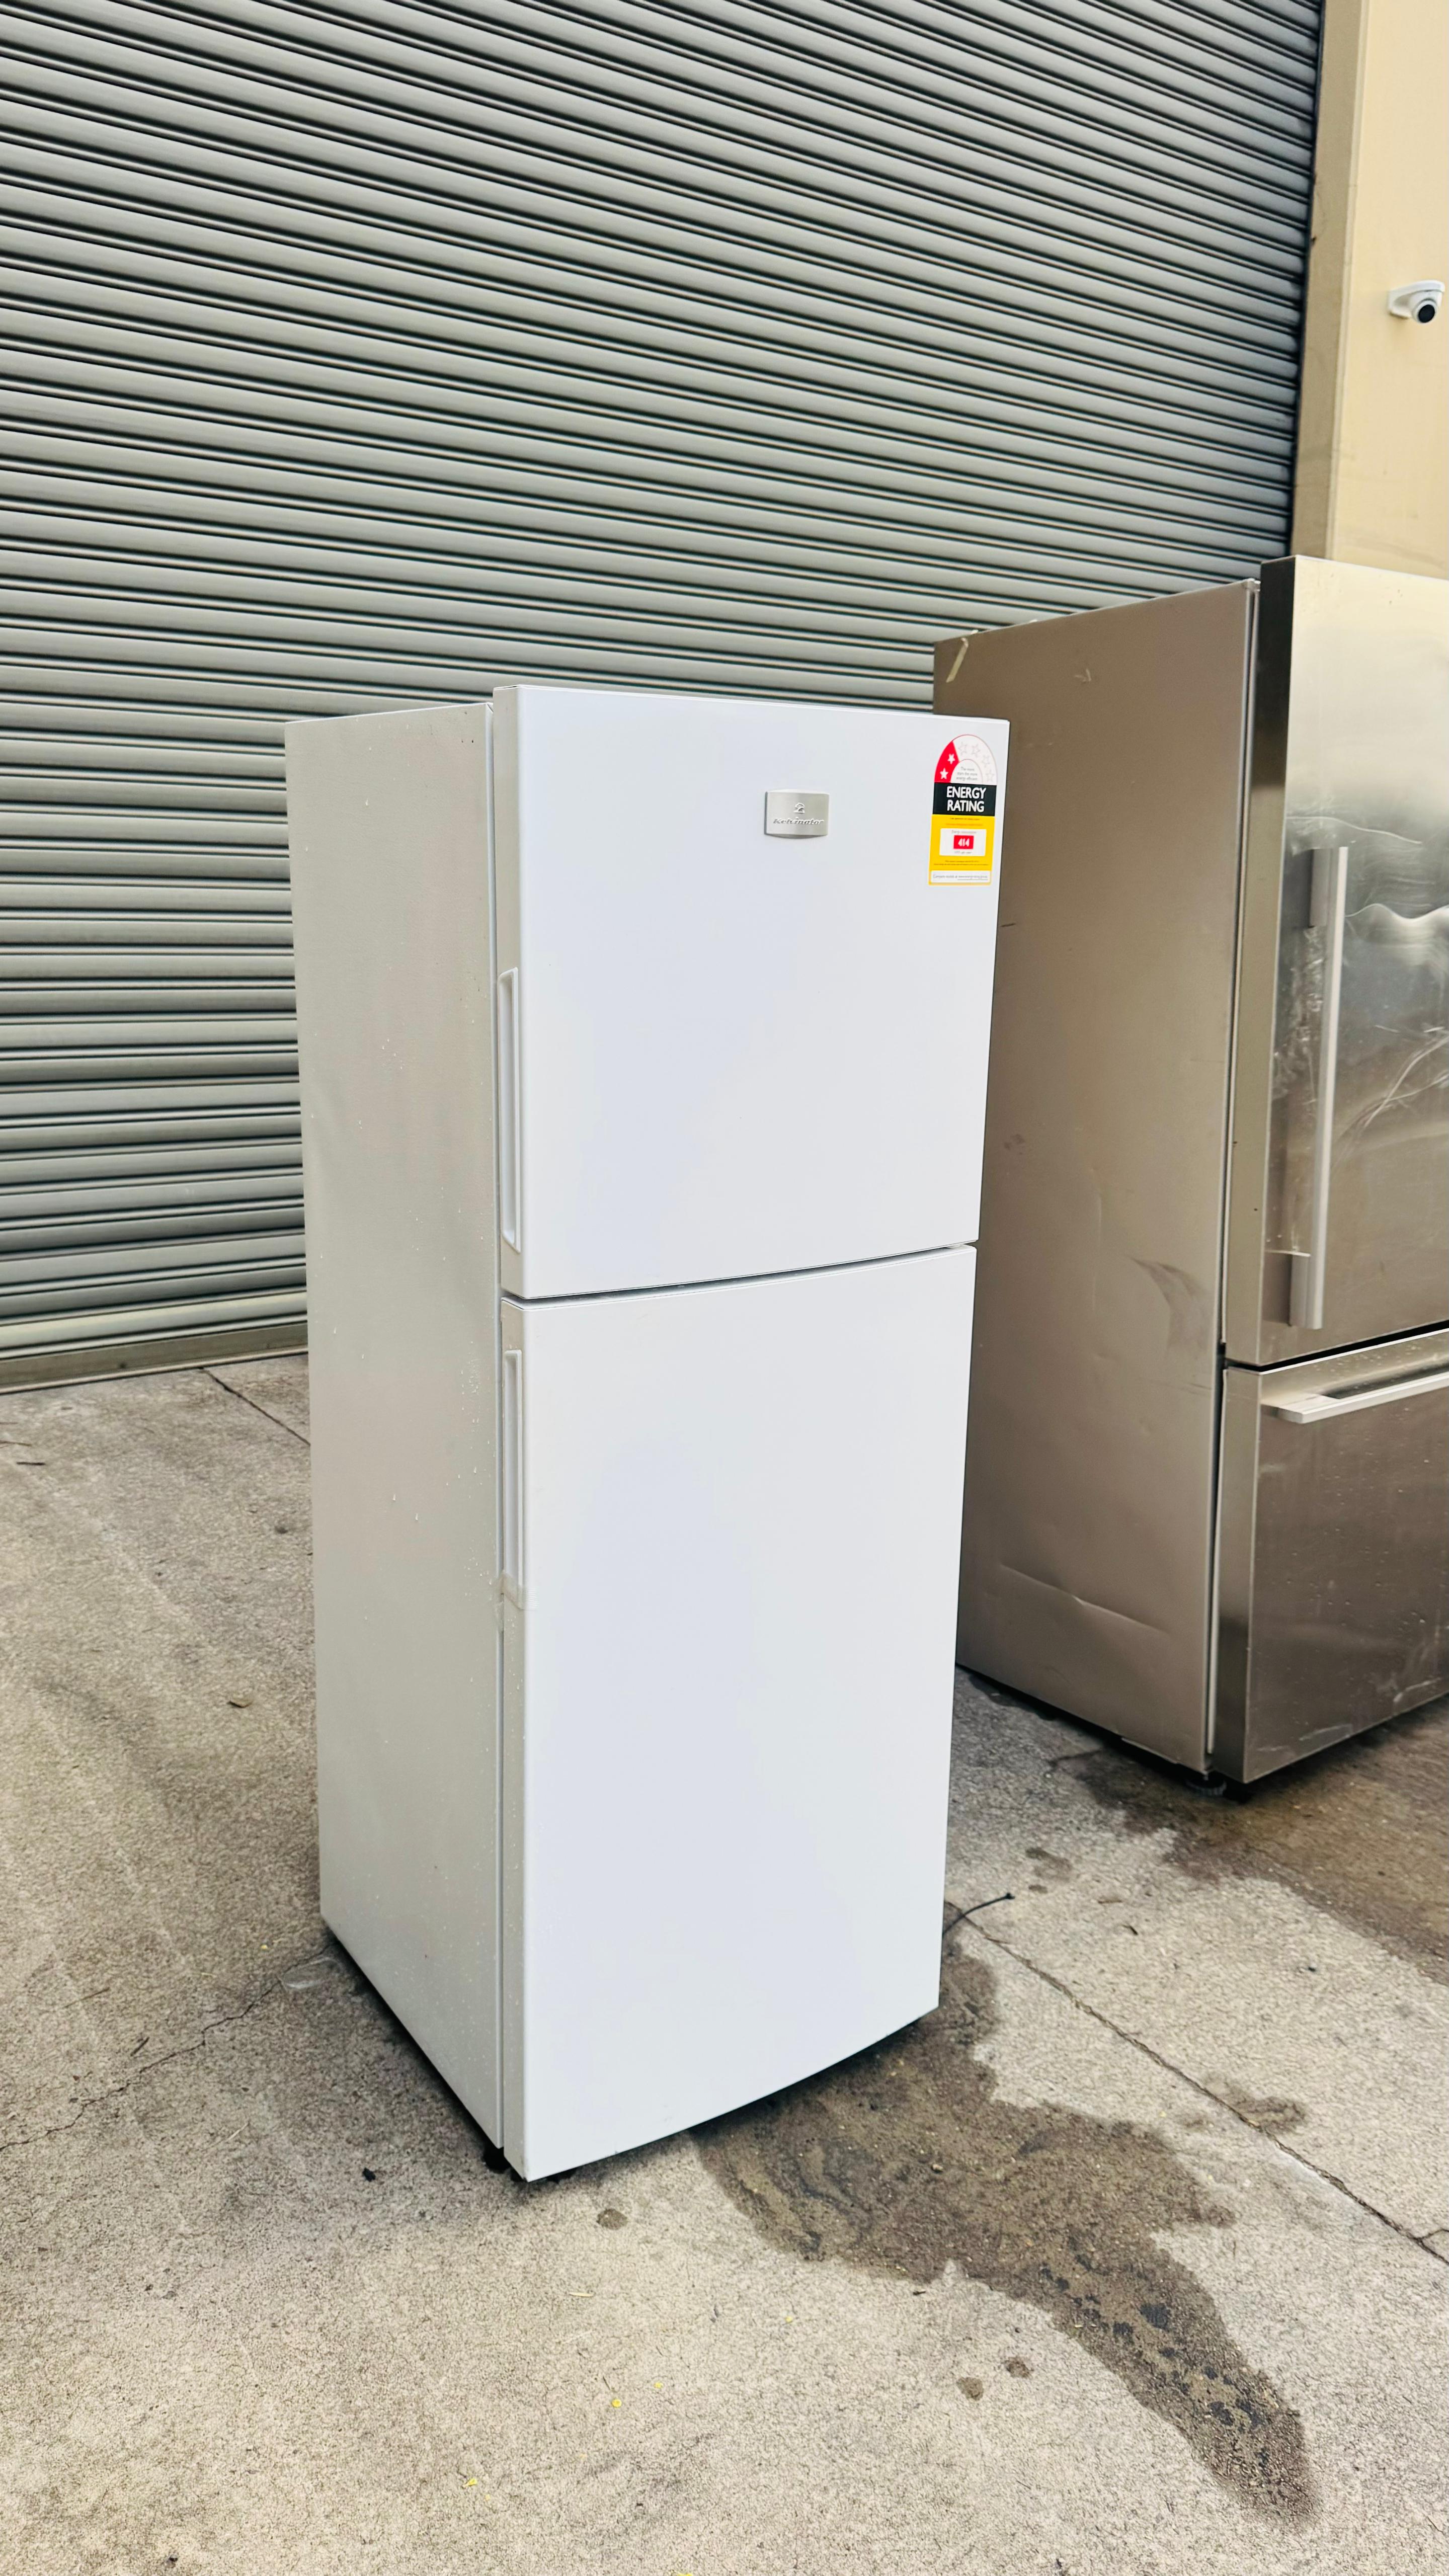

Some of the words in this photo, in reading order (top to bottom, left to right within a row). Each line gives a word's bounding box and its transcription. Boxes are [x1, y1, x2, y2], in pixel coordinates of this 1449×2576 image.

[946, 786, 986, 799] ENERGY
[947, 799, 985, 813] RATING
[773, 817, 825, 825] Kelvinator
